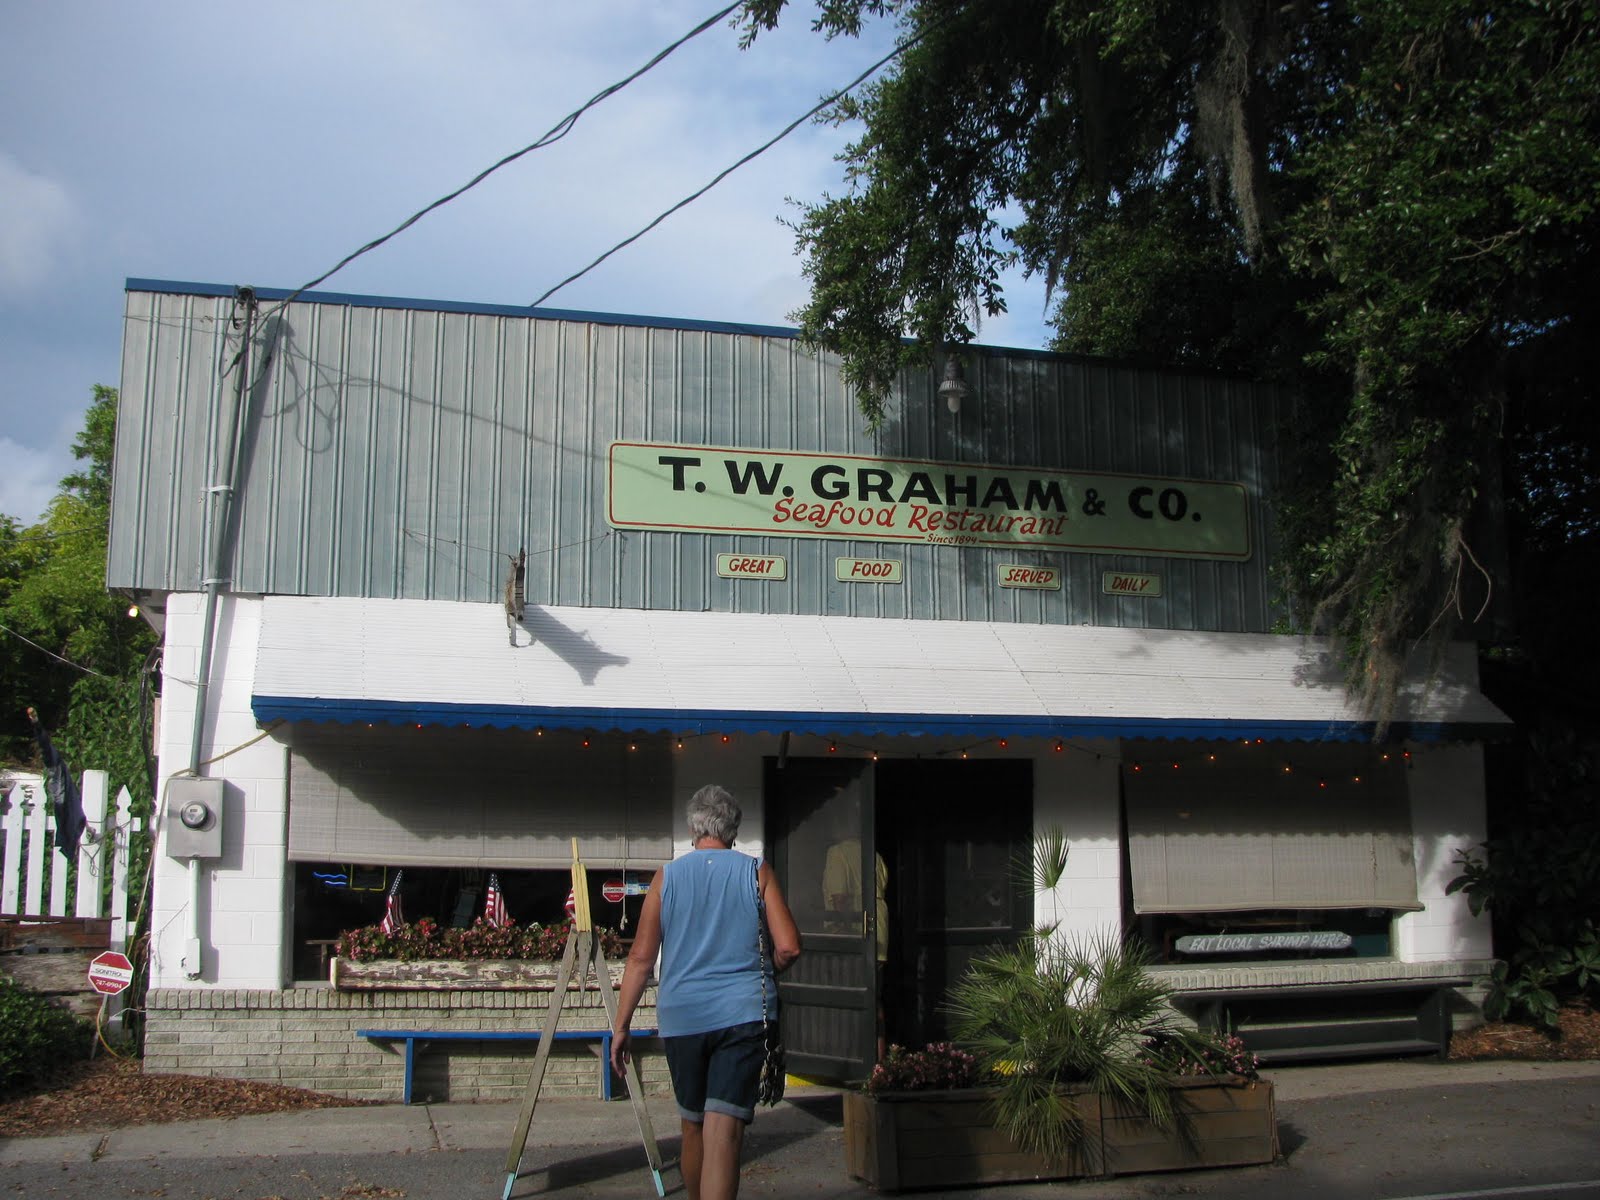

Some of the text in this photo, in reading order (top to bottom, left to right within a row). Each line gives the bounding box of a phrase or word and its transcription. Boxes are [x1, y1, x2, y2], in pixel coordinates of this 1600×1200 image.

[658, 456, 1202, 522] T. W. GRAHAM & CO.
[772, 497, 1069, 536] Seafood Restaurant
[729, 558, 775, 574] GREAT
[851, 561, 893, 577] FOOD
[1004, 568, 1054, 584] SERVED
[1112, 576, 1150, 591] DAILY
[1189, 932, 1344, 951] EAT LOCAL SHRIMP HERE
